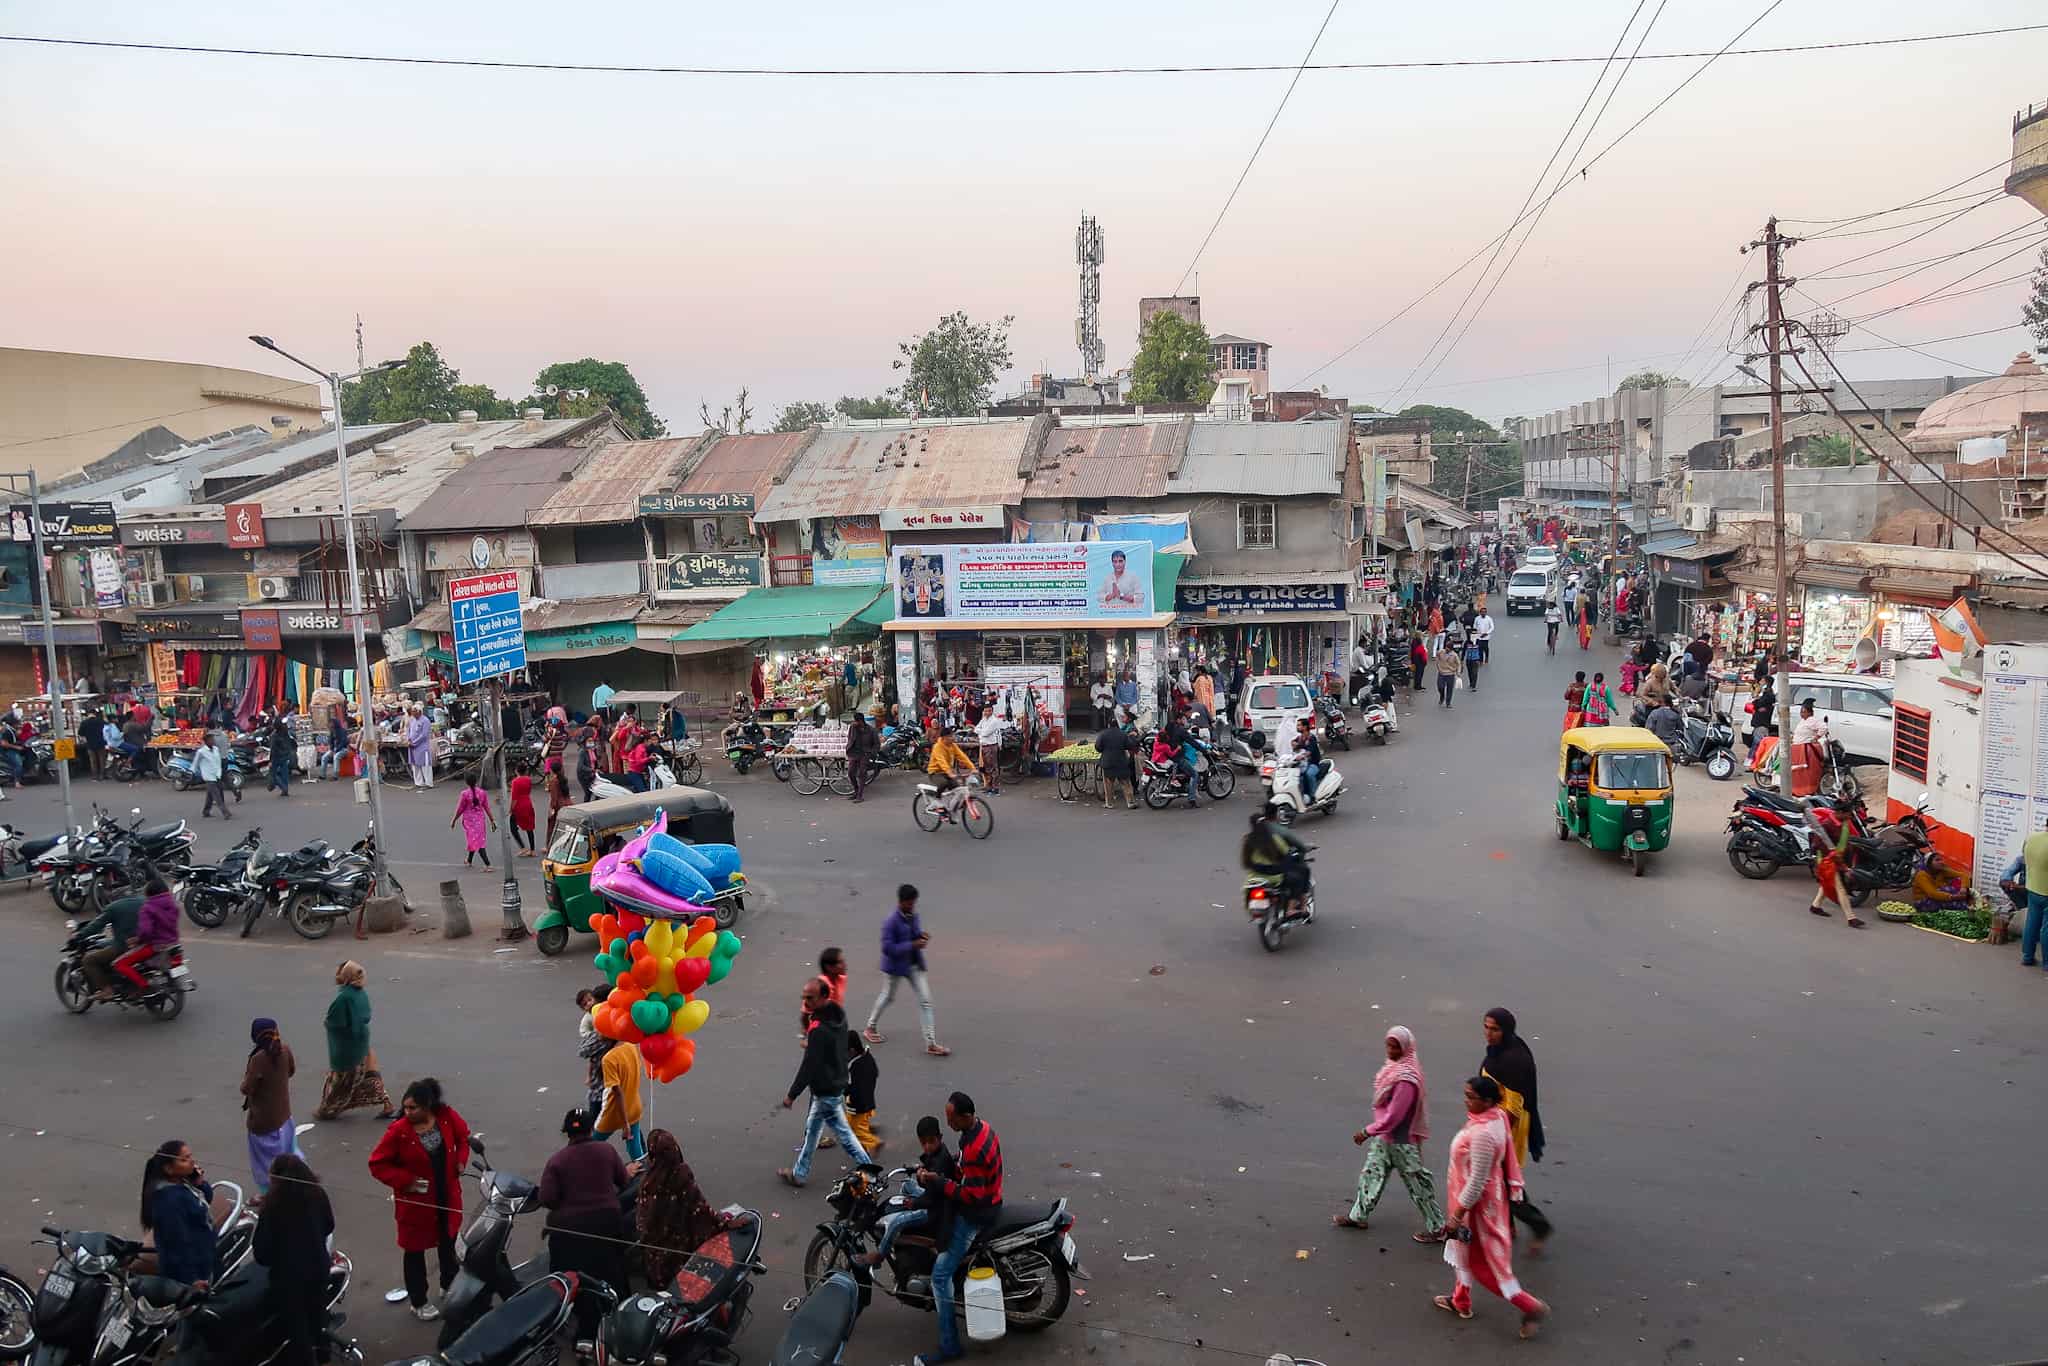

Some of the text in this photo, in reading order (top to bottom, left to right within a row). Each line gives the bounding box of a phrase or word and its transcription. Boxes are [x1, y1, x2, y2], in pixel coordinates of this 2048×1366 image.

[664, 494, 695, 510] યુનિક
[699, 494, 729, 510] બ્યુટી
[732, 494, 748, 506] કેર
[903, 516, 925, 527] નૂતન
[960, 512, 984, 522] પેલેસ
[134, 525, 182, 542] અલંકાર
[689, 554, 727, 573] યુનિક
[288, 611, 339, 629] અલંકાર
